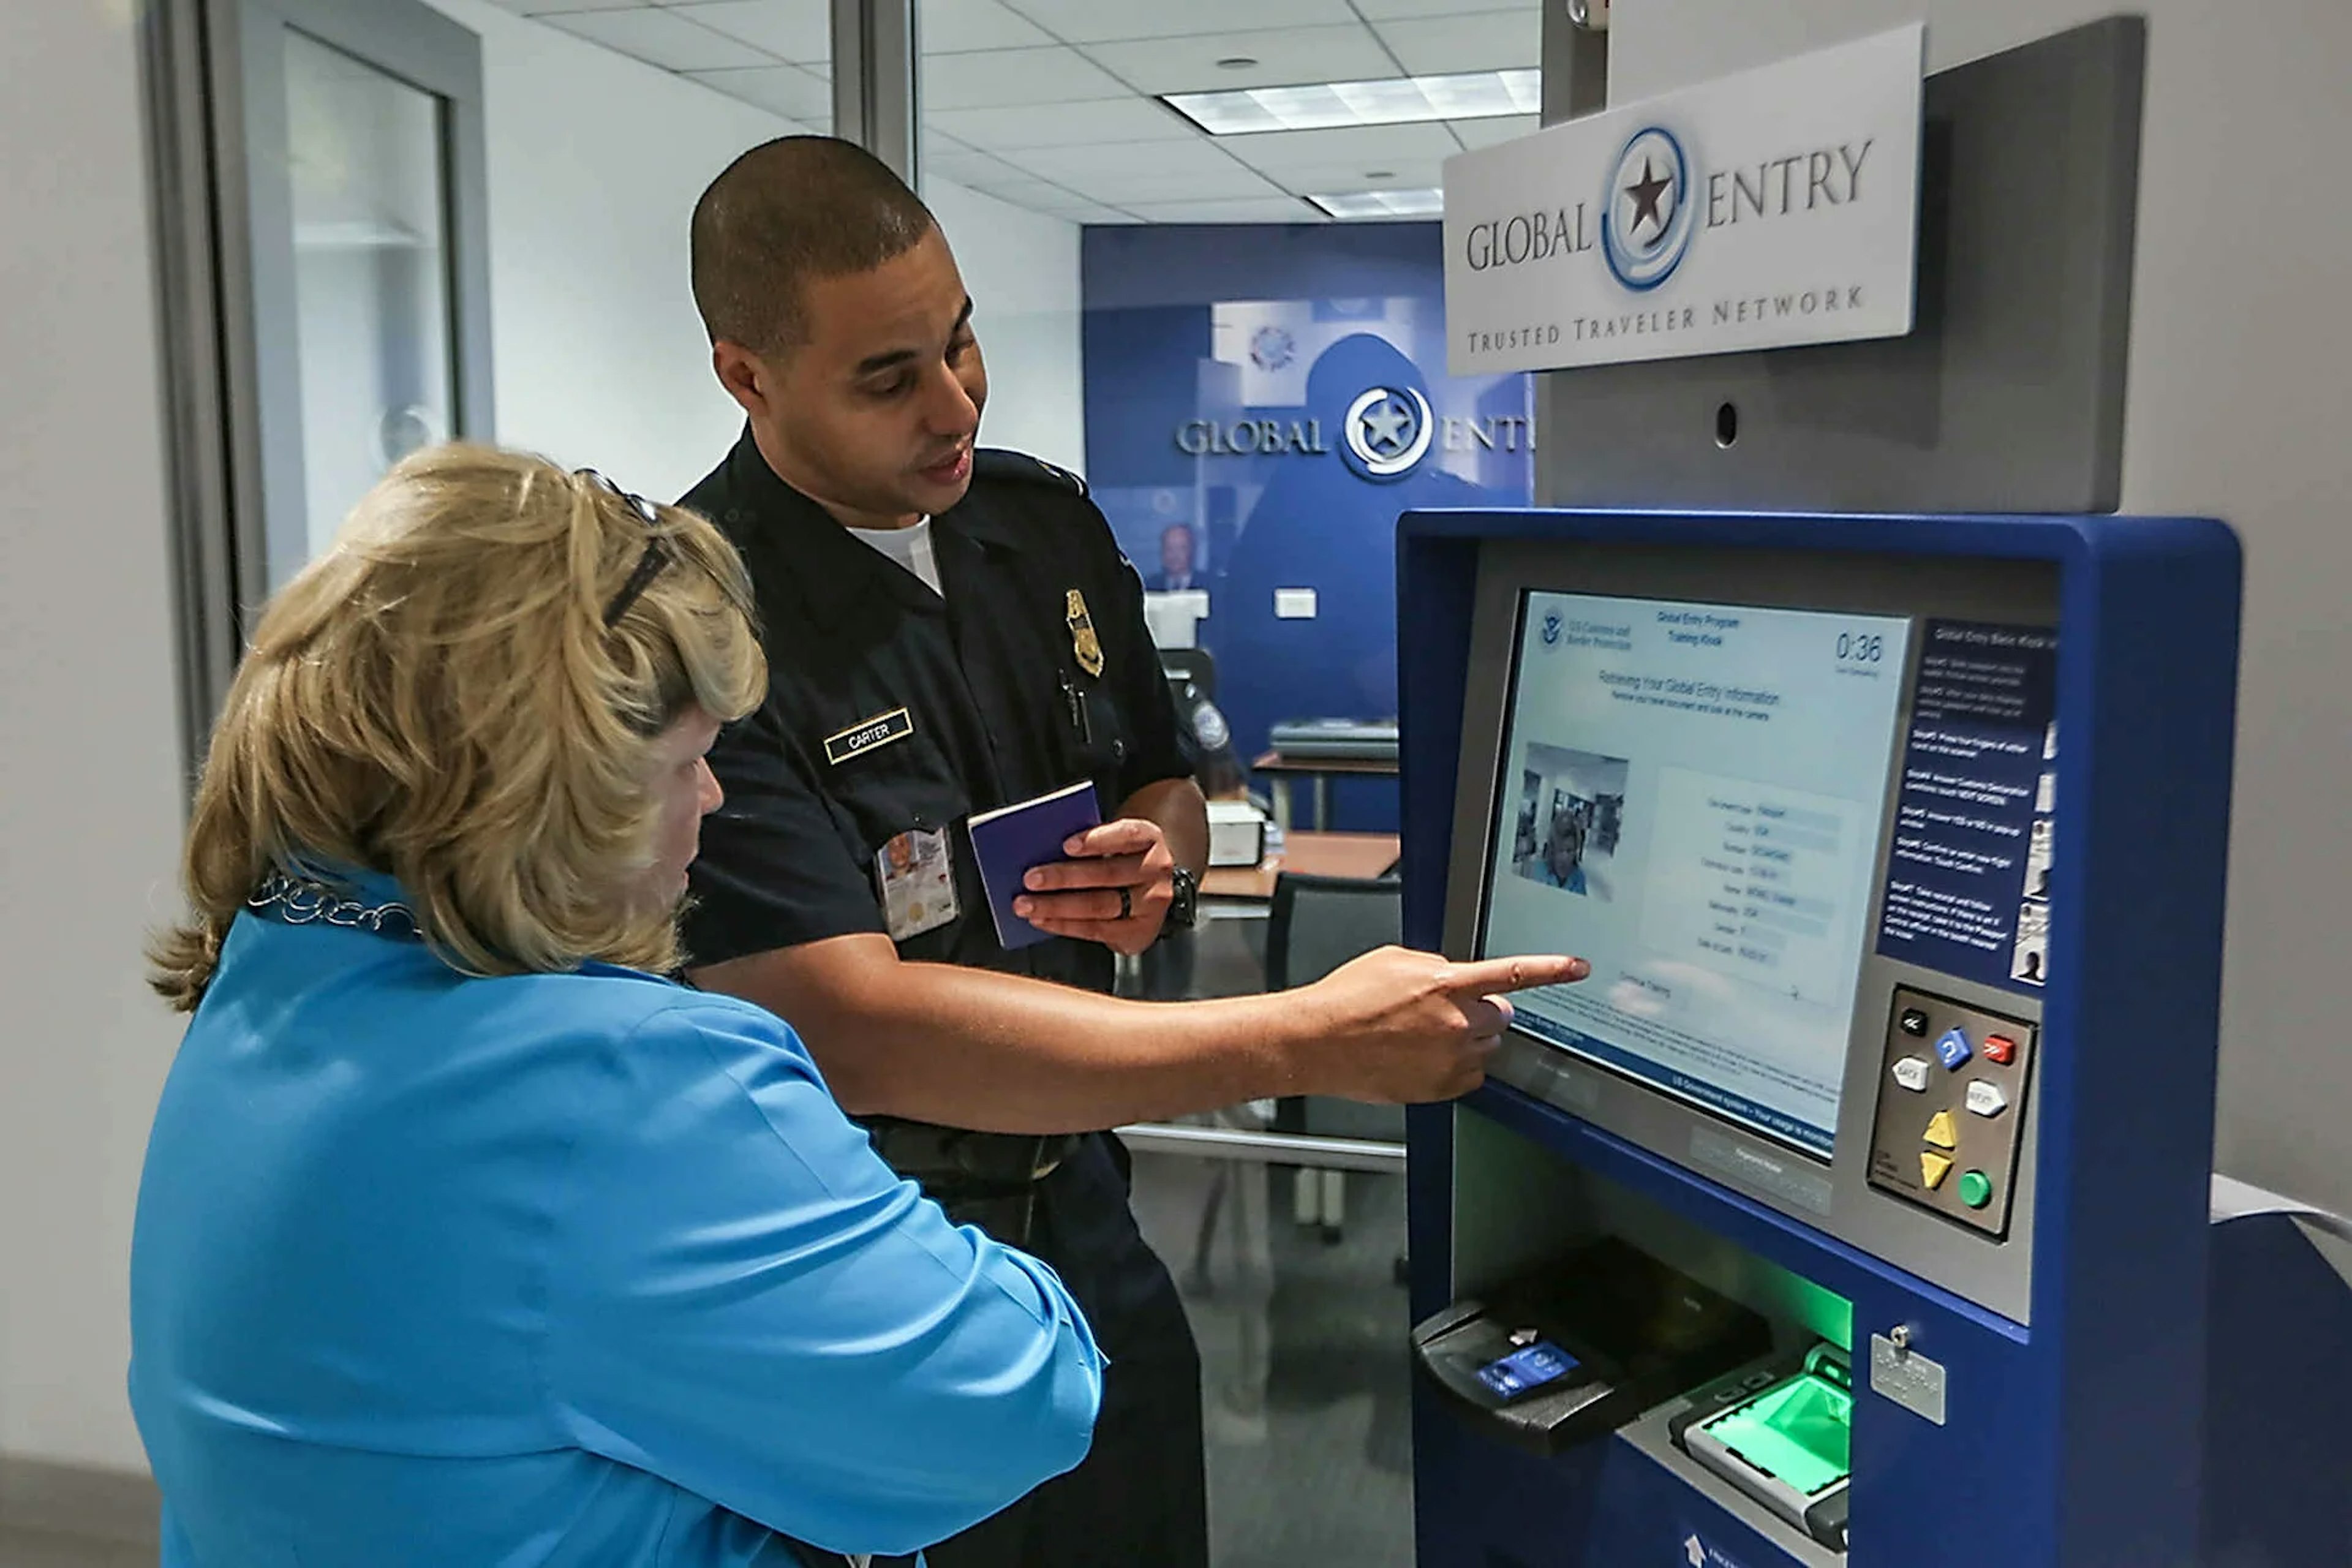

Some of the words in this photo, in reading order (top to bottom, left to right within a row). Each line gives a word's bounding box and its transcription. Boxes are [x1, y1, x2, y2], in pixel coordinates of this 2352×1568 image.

[1467, 202, 1593, 272] GLOBAL
[1705, 138, 1875, 230] ENTRY
[1468, 324, 1560, 354] TRUSTED
[1574, 306, 1695, 341] TRAVELER
[1713, 285, 1863, 326] NETWORK
[1175, 417, 1332, 455] GLOBAL
[1836, 633, 1882, 662] 0:36
[848, 723, 891, 750] CARTER
